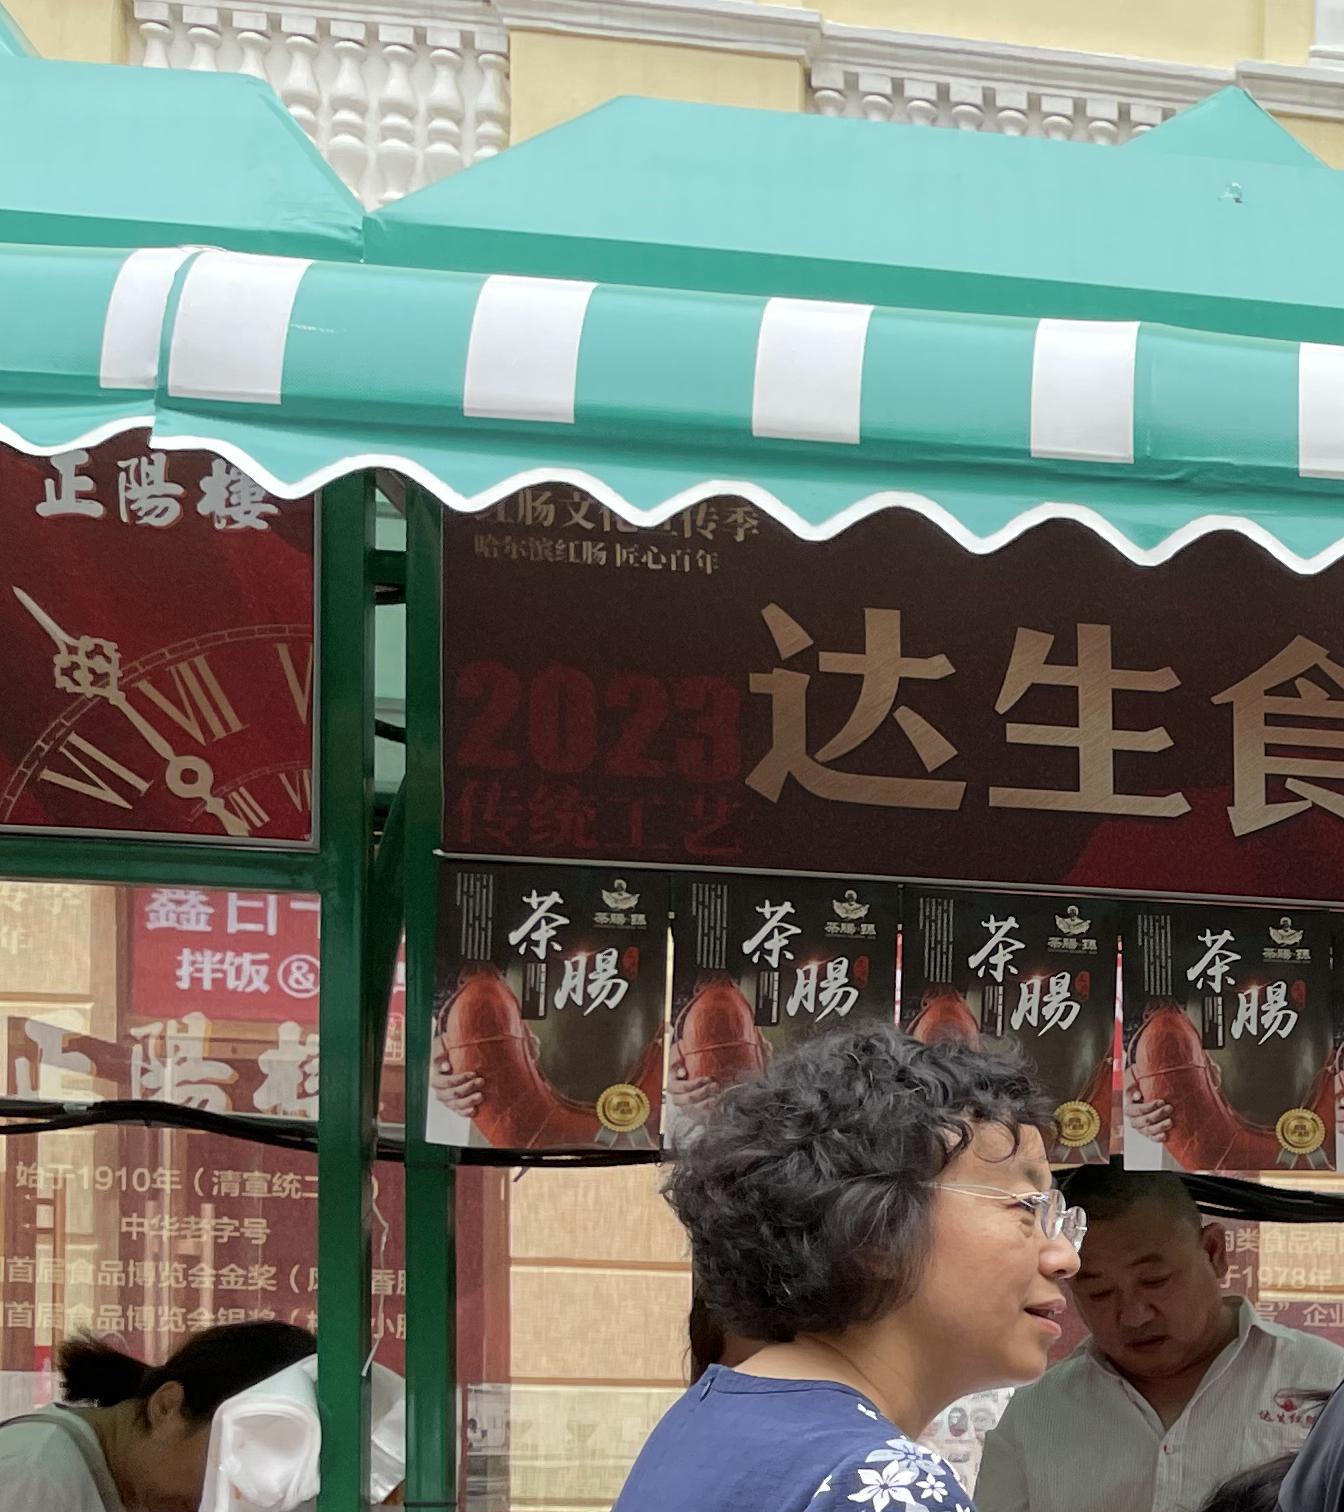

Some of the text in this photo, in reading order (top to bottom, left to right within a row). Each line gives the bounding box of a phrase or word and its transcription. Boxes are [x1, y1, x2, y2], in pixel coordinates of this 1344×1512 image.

[455, 660, 745, 782] 2023
[119, 1212, 271, 1245] 中华老字号
